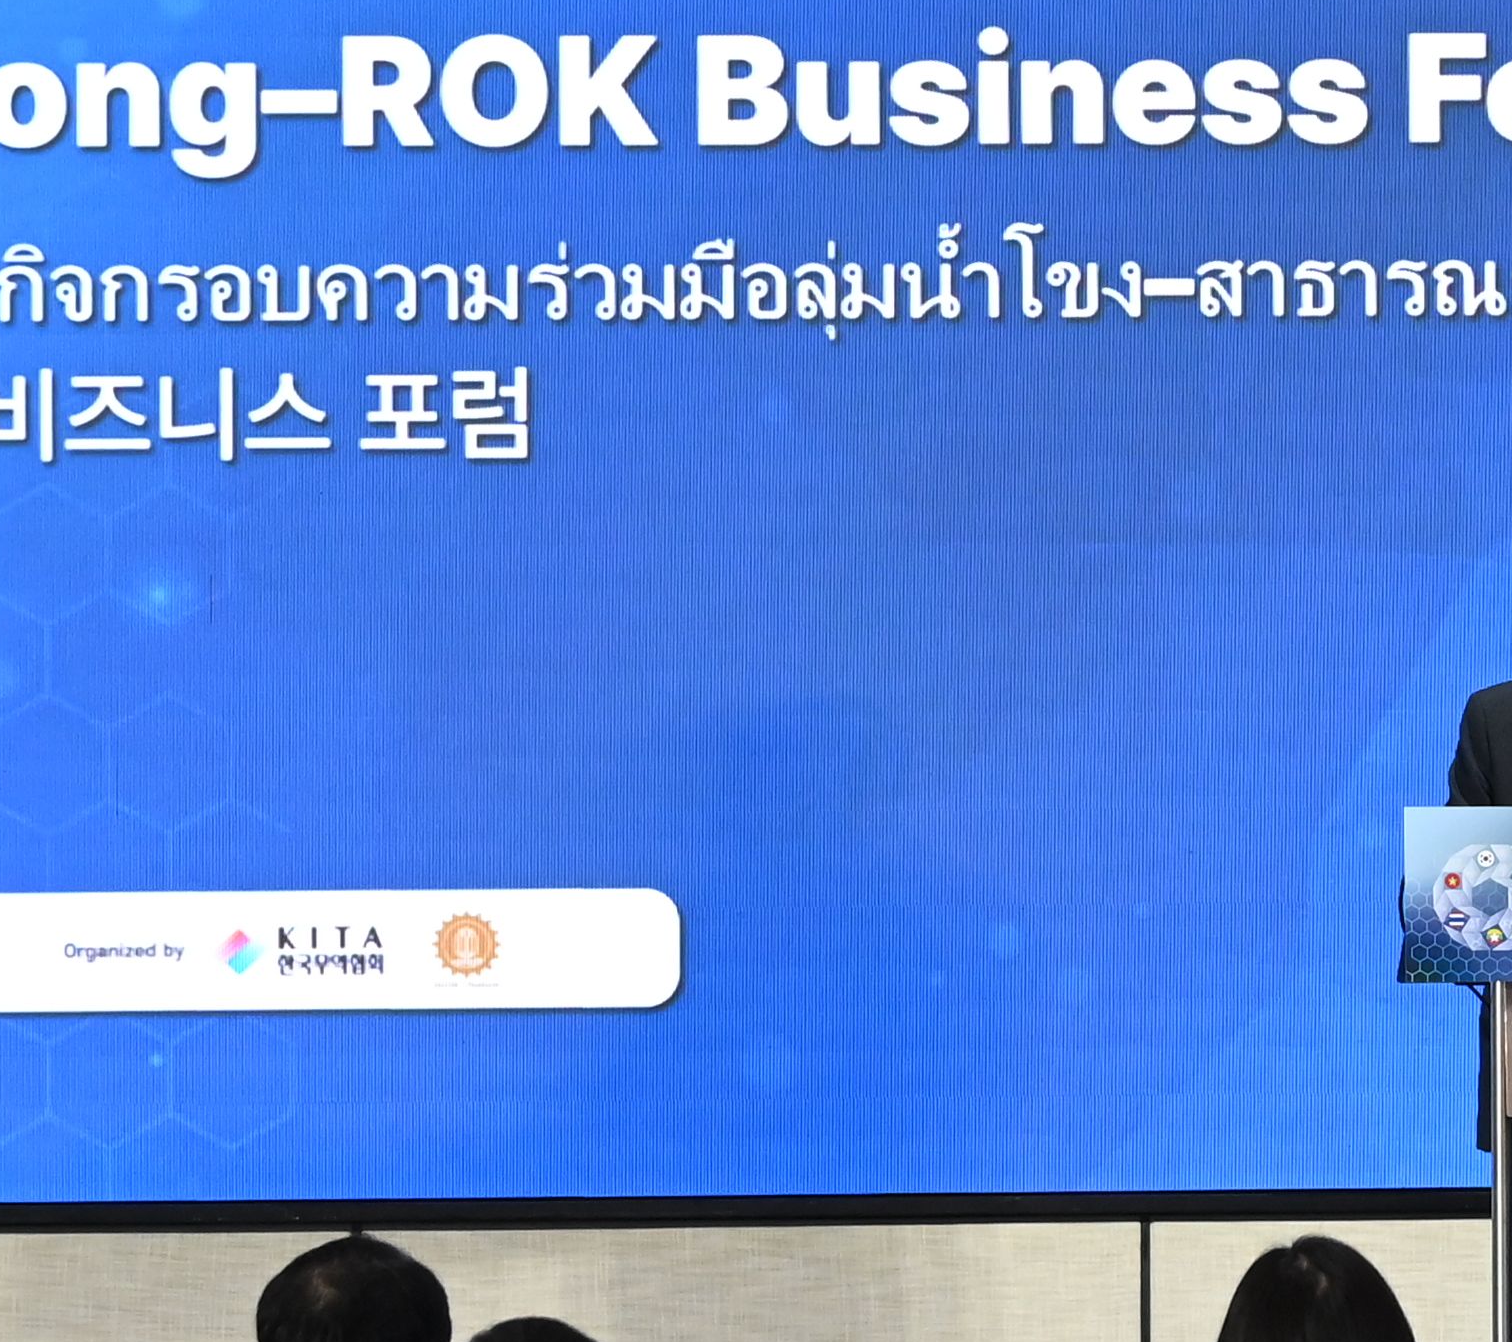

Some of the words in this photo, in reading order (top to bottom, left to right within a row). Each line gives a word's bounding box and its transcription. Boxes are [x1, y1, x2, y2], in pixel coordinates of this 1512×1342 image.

[695, 25, 1370, 149] Business
[358, 365, 529, 460] 포럼
[64, 942, 158, 964] Organized
[163, 942, 186, 964] by
[277, 925, 383, 950] KITA
